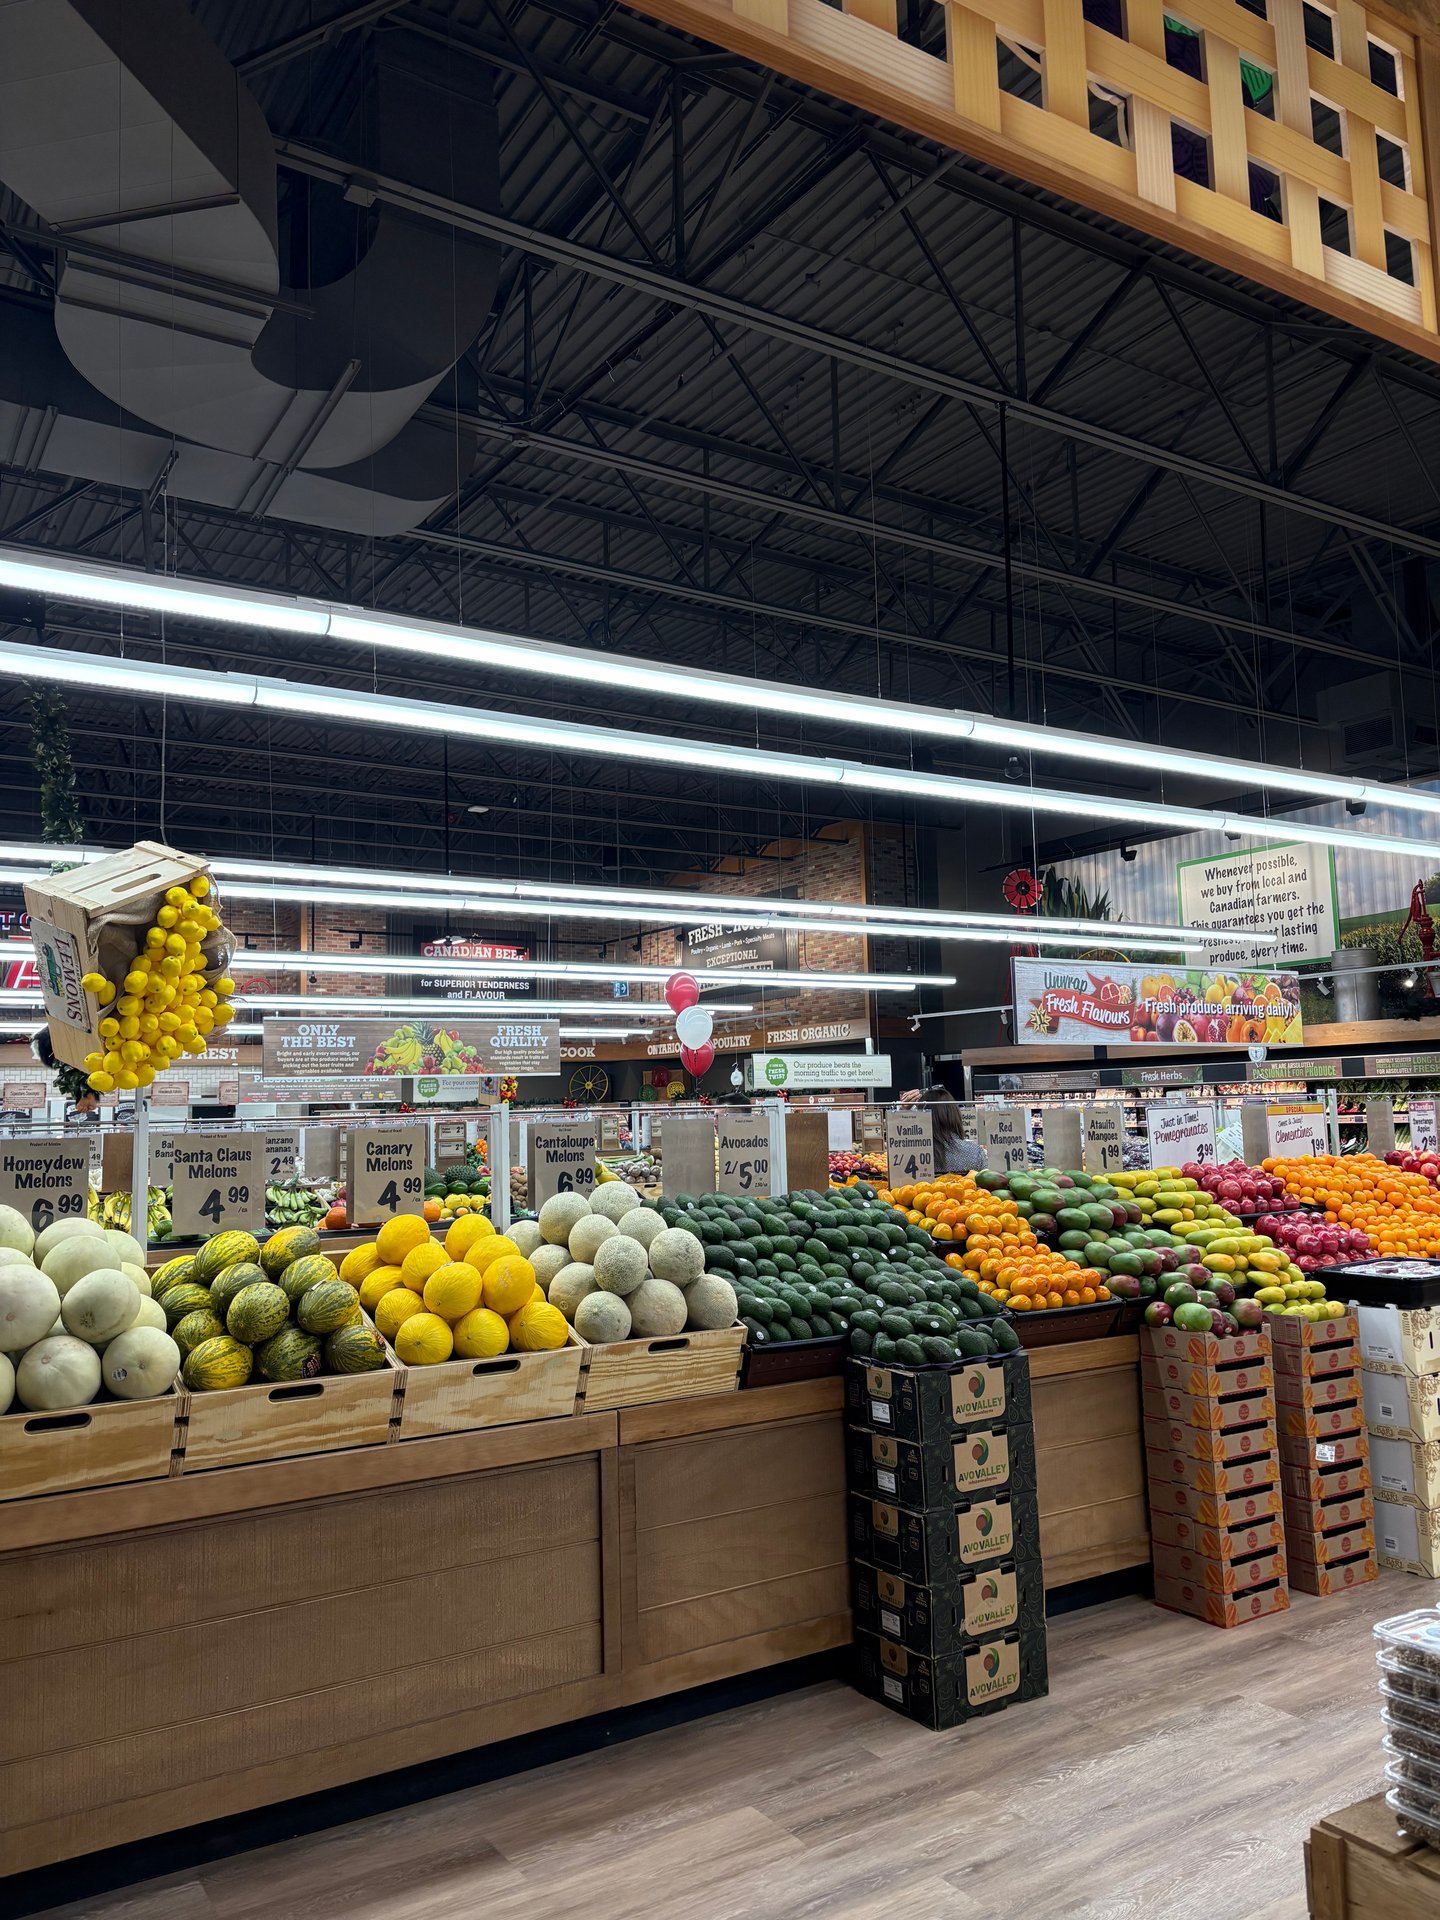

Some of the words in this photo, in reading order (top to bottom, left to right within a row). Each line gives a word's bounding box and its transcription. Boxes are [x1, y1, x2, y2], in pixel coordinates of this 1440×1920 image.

[1204, 864, 1254, 882] Whenever
[1256, 854, 1298, 874] possible,
[1200, 887, 1215, 899] we
[1216, 884, 1233, 896] buy
[1236, 880, 1260, 893] from
[1262, 872, 1286, 888] local
[1288, 869, 1308, 884] and
[1209, 896, 1255, 914] Canadian
[1256, 890, 1300, 907] farmers.
[1267, 909, 1285, 924] you
[1287, 905, 1304, 921] get
[1306, 902, 1325, 917] the
[688, 923, 723, 946] FRESH
[1281, 922, 1318, 938] lasting
[423, 946, 492, 959] CANADIAN
[706, 949, 759, 968] EXCEPTIONAL
[1209, 950, 1248, 966] produce,
[1250, 945, 1279, 960] every
[1281, 941, 1308, 955] time.
[53, 937, 82, 1022] LEMONS
[420, 979, 432, 987] for
[434, 979, 476, 988] SUPERIOR
[478, 981, 530, 990] TENDERNESS
[1044, 971, 1088, 994] Unwrap
[447, 991, 463, 999] and
[465, 991, 505, 1000] FLAVOUR
[1046, 993, 1080, 1015] Fresh
[1082, 1000, 1131, 1025] Flavours
[1144, 999, 1178, 1015] Fresh
[1179, 1001, 1223, 1018] produce
[1225, 1002, 1265, 1020] arriving
[1266, 1003, 1294, 1020] daily!
[297, 1024, 340, 1036] ONLY
[497, 1025, 542, 1036] FRESH
[767, 1028, 799, 1044] FRESH
[800, 1024, 851, 1041] ORGANIC
[280, 1036, 313, 1048] THE
[316, 1036, 356, 1048] BEST
[489, 1036, 549, 1048] QUALITY
[647, 1041, 681, 1056] ONTARIO
[713, 1035, 751, 1049] POULTRY
[560, 1047, 596, 1058] COOK
[793, 1060, 806, 1069] Our
[807, 1061, 833, 1070] produce
[834, 1061, 851, 1069] beats
[852, 1061, 862, 1069] the
[1304, 1065, 1337, 1077] PRODUCE
[793, 1070, 820, 1078] morning
[847, 1070, 857, 1078] get
[1140, 1070, 1160, 1082] Fresh
[1160, 1070, 1183, 1080] Herbs
[998, 1121, 1013, 1132] Red
[1160, 1118, 1177, 1129] Just
[1176, 1115, 1183, 1125] in
[1183, 1110, 1199, 1124] Time!
[896, 1124, 923, 1136] Vanilla
[1087, 1131, 1118, 1142] Mangoes
[1153, 1123, 1209, 1144] Pomegranates
[1275, 1126, 1314, 1144] Clementines
[535, 1135, 595, 1149] Cantaloupe
[721, 1135, 769, 1149] Avocados
[889, 1137, 932, 1148] Persimmon
[990, 1134, 1023, 1145] Mangoes
[174, 1149, 213, 1163] Santa
[216, 1147, 252, 1162] Claus
[366, 1141, 413, 1157] Canary
[546, 1150, 585, 1163] Melons
[3, 1154, 85, 1173] Honeydew
[188, 1164, 237, 1179] Melons
[366, 1157, 413, 1172] Melons
[15, 1173, 73, 1189] Melons
[955, 1396, 1003, 1415] AVOVALLEY
[958, 1463, 1007, 1483] AVOVALLEY
[963, 1533, 1011, 1555] AVOVALLEY
[969, 1672, 1017, 1698] AVOVALLEY
